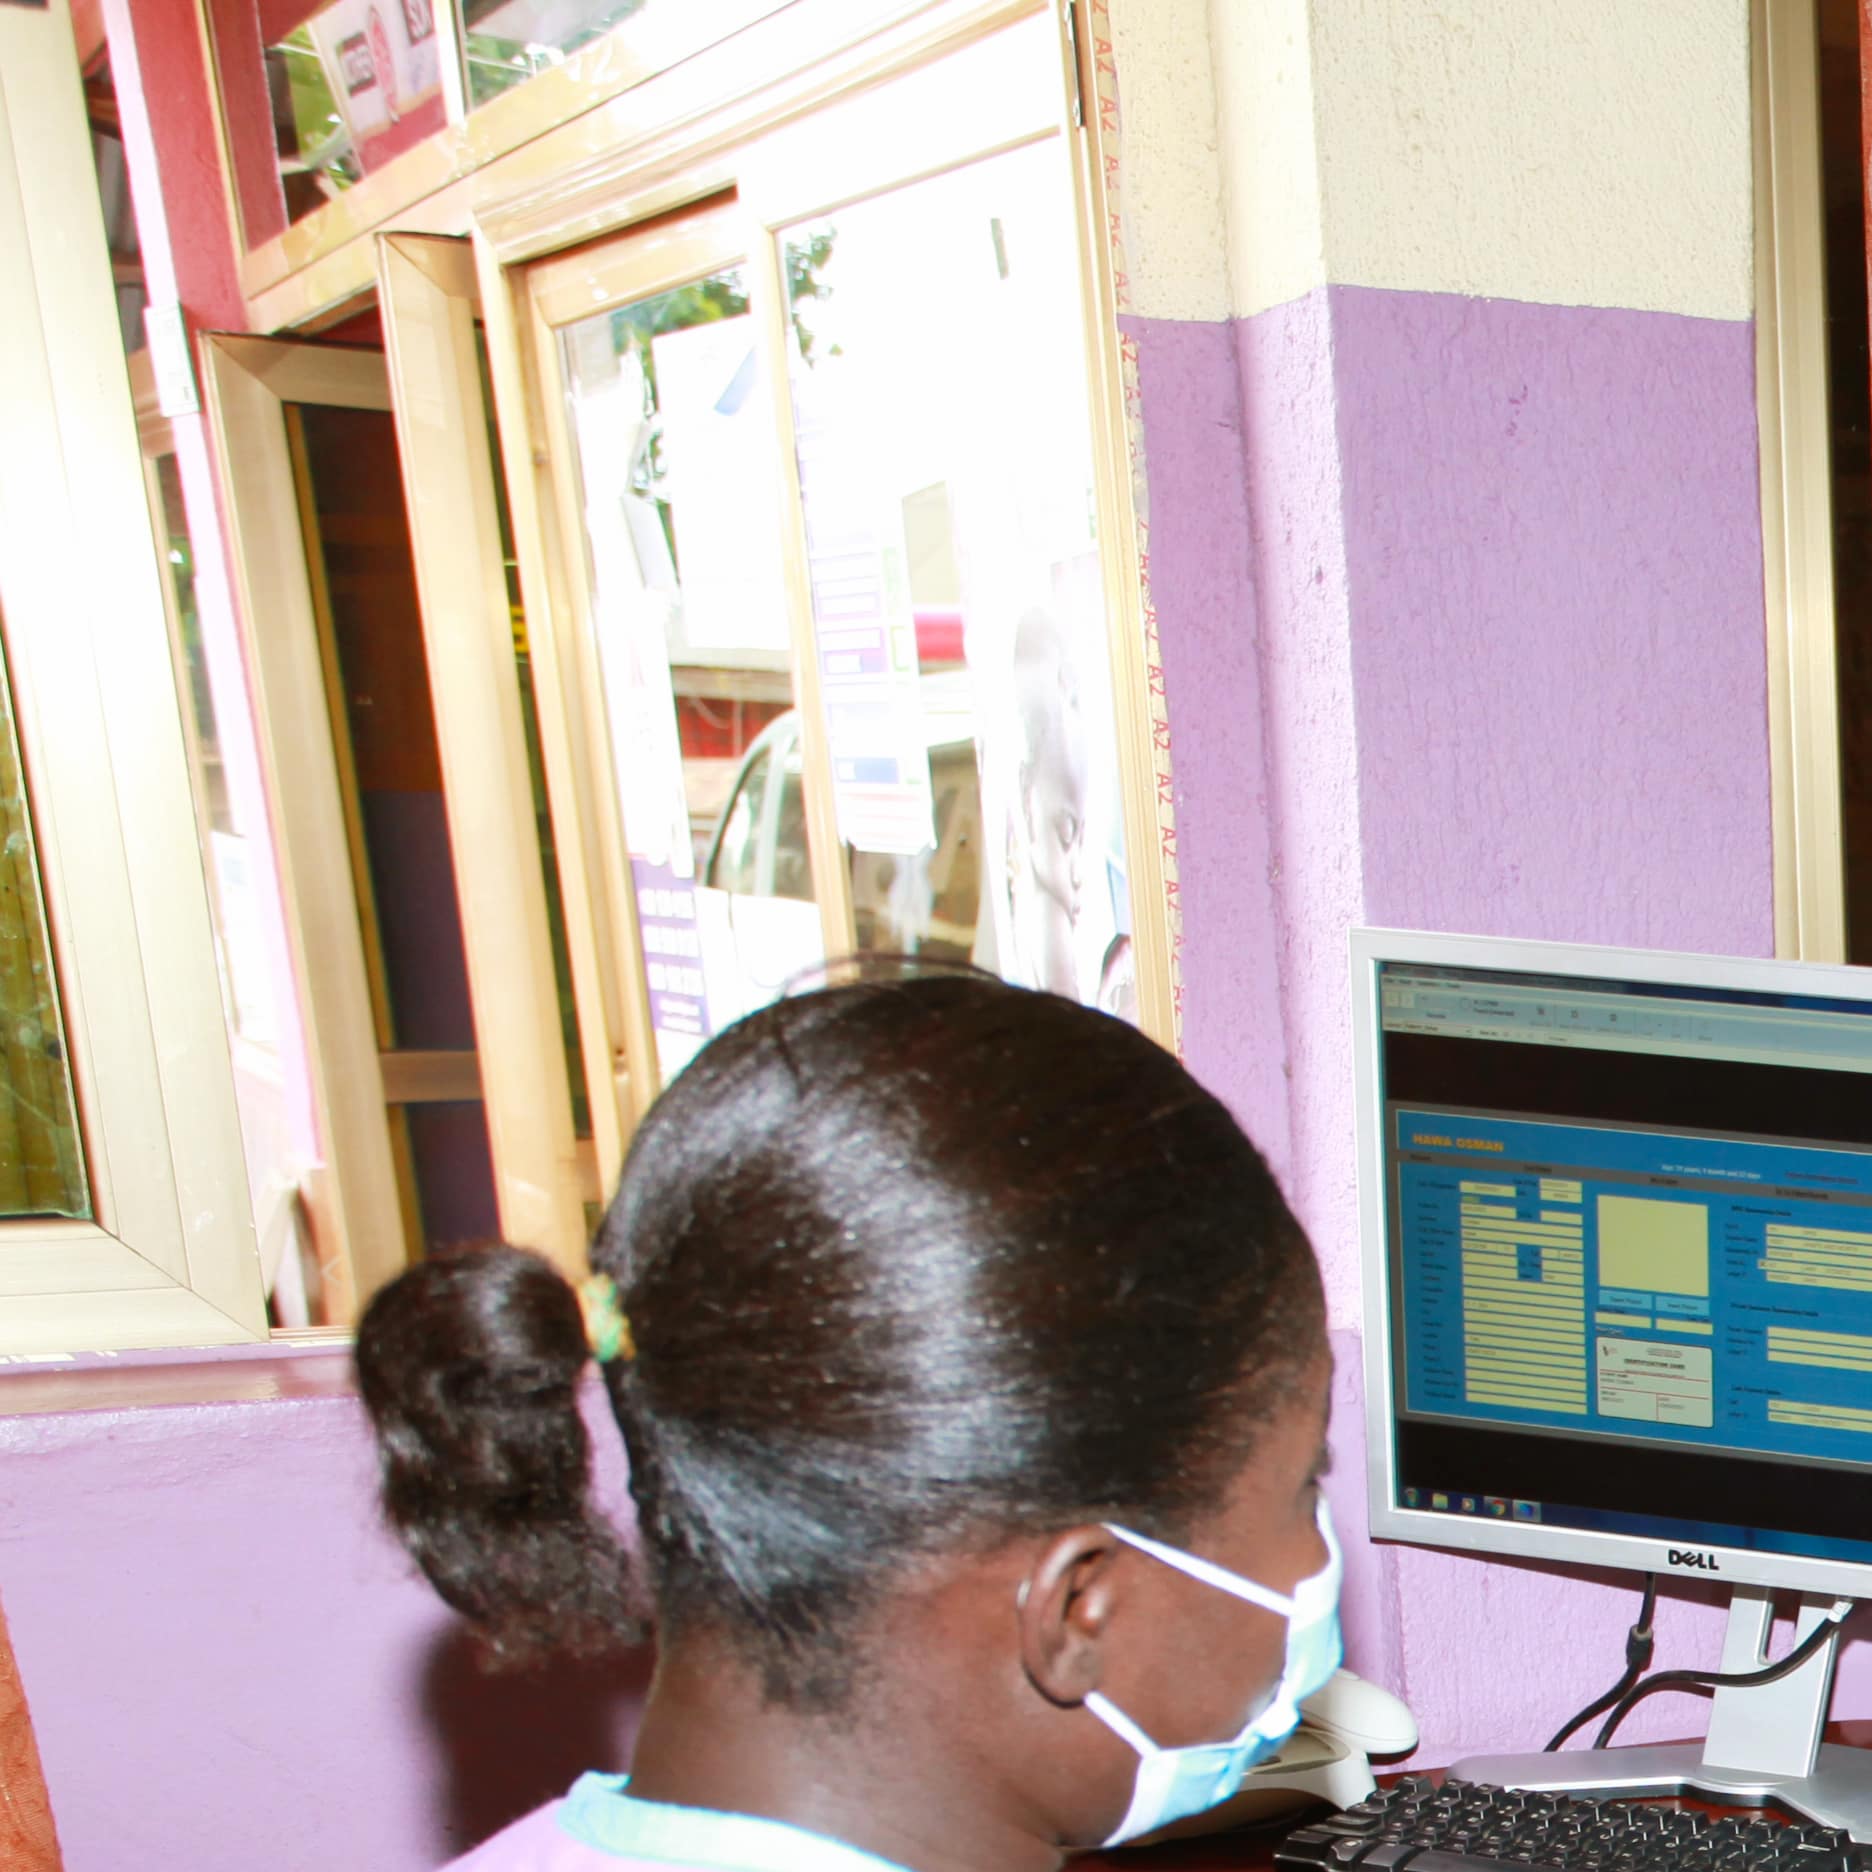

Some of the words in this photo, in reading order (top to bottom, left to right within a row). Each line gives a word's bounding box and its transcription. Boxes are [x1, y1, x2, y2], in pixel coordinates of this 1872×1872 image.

[1148, 663, 1164, 698] A2
[1152, 717, 1172, 752] A2
[1157, 771, 1174, 806] A2
[1161, 824, 1178, 858] A2
[1667, 1549, 1720, 1571] DELL
